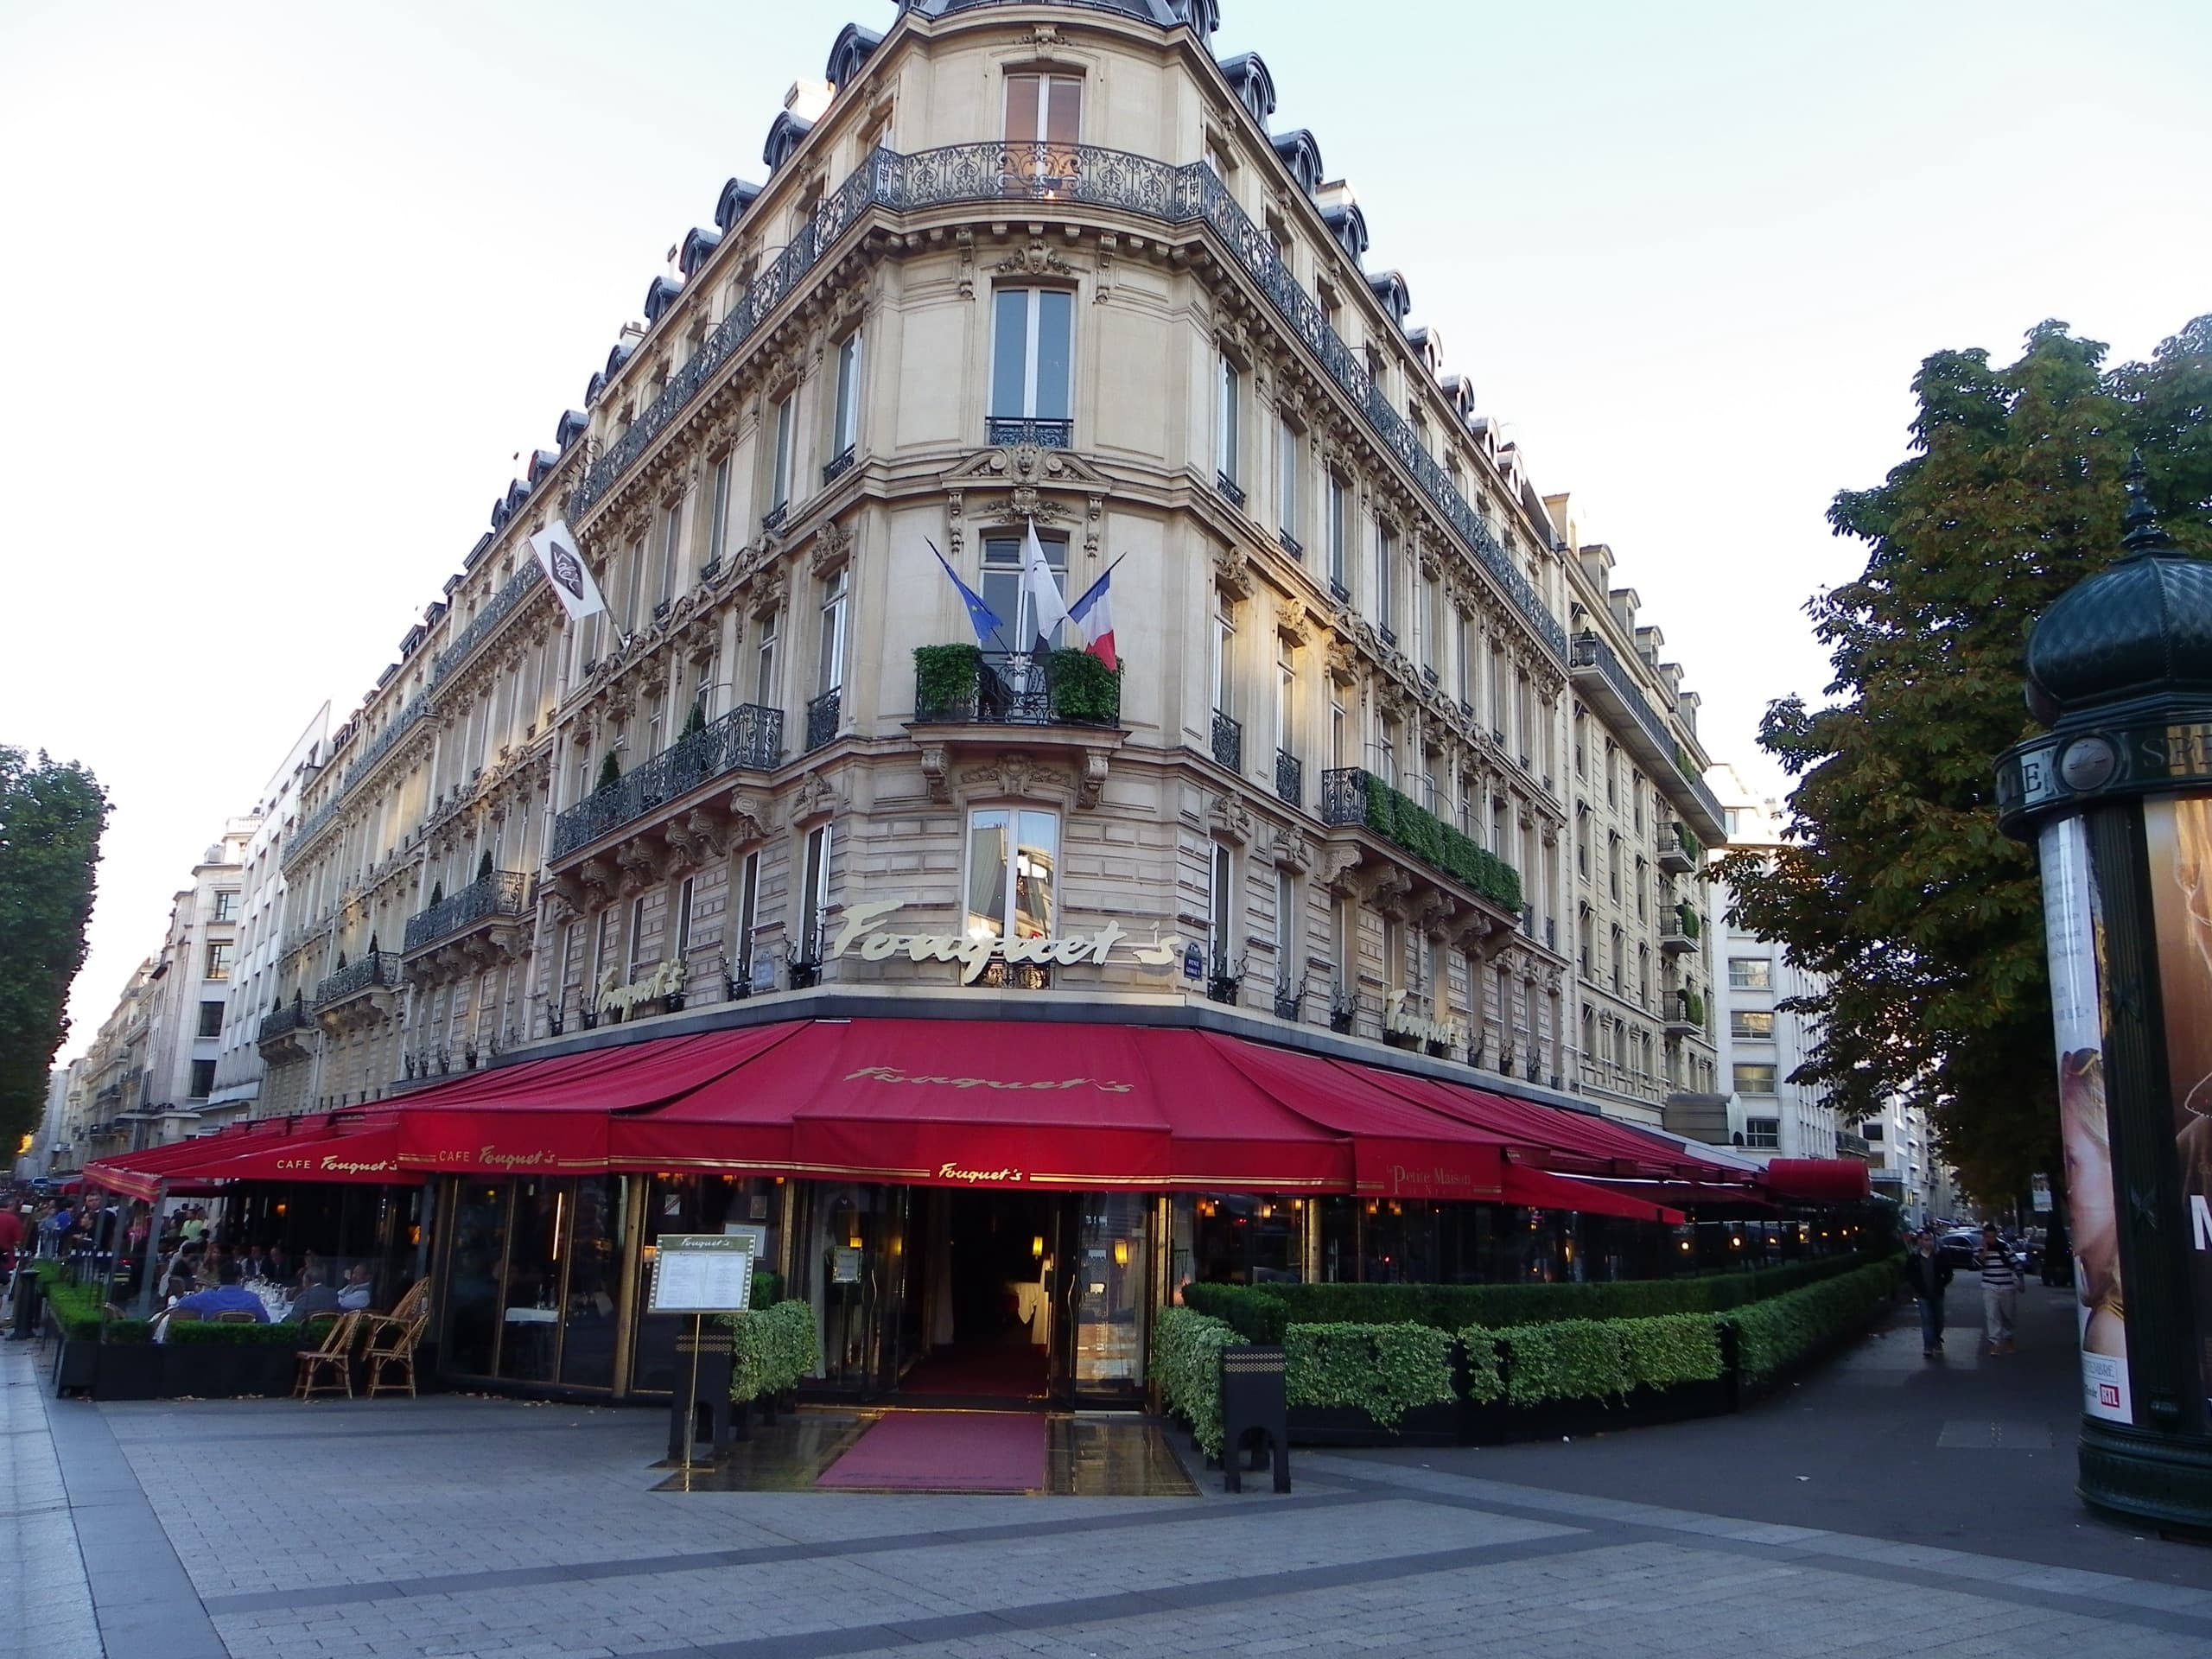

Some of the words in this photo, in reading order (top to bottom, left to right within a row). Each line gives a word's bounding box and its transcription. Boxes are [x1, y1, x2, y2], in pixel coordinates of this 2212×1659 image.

[833, 899, 1181, 985] Fouquet's
[594, 959, 685, 1023] Fouquet's
[843, 1066, 1135, 1093] Fouquet's
[276, 1159, 312, 1170] CAFE
[320, 1154, 398, 1175] Fouquet's
[439, 1150, 470, 1163] CAFE
[478, 1145, 556, 1171] Fouquet's
[938, 1161, 1023, 1185] Fouquet's
[681, 1236, 731, 1249] Fouquet's
[2101, 1386, 2120, 1406] RTL
